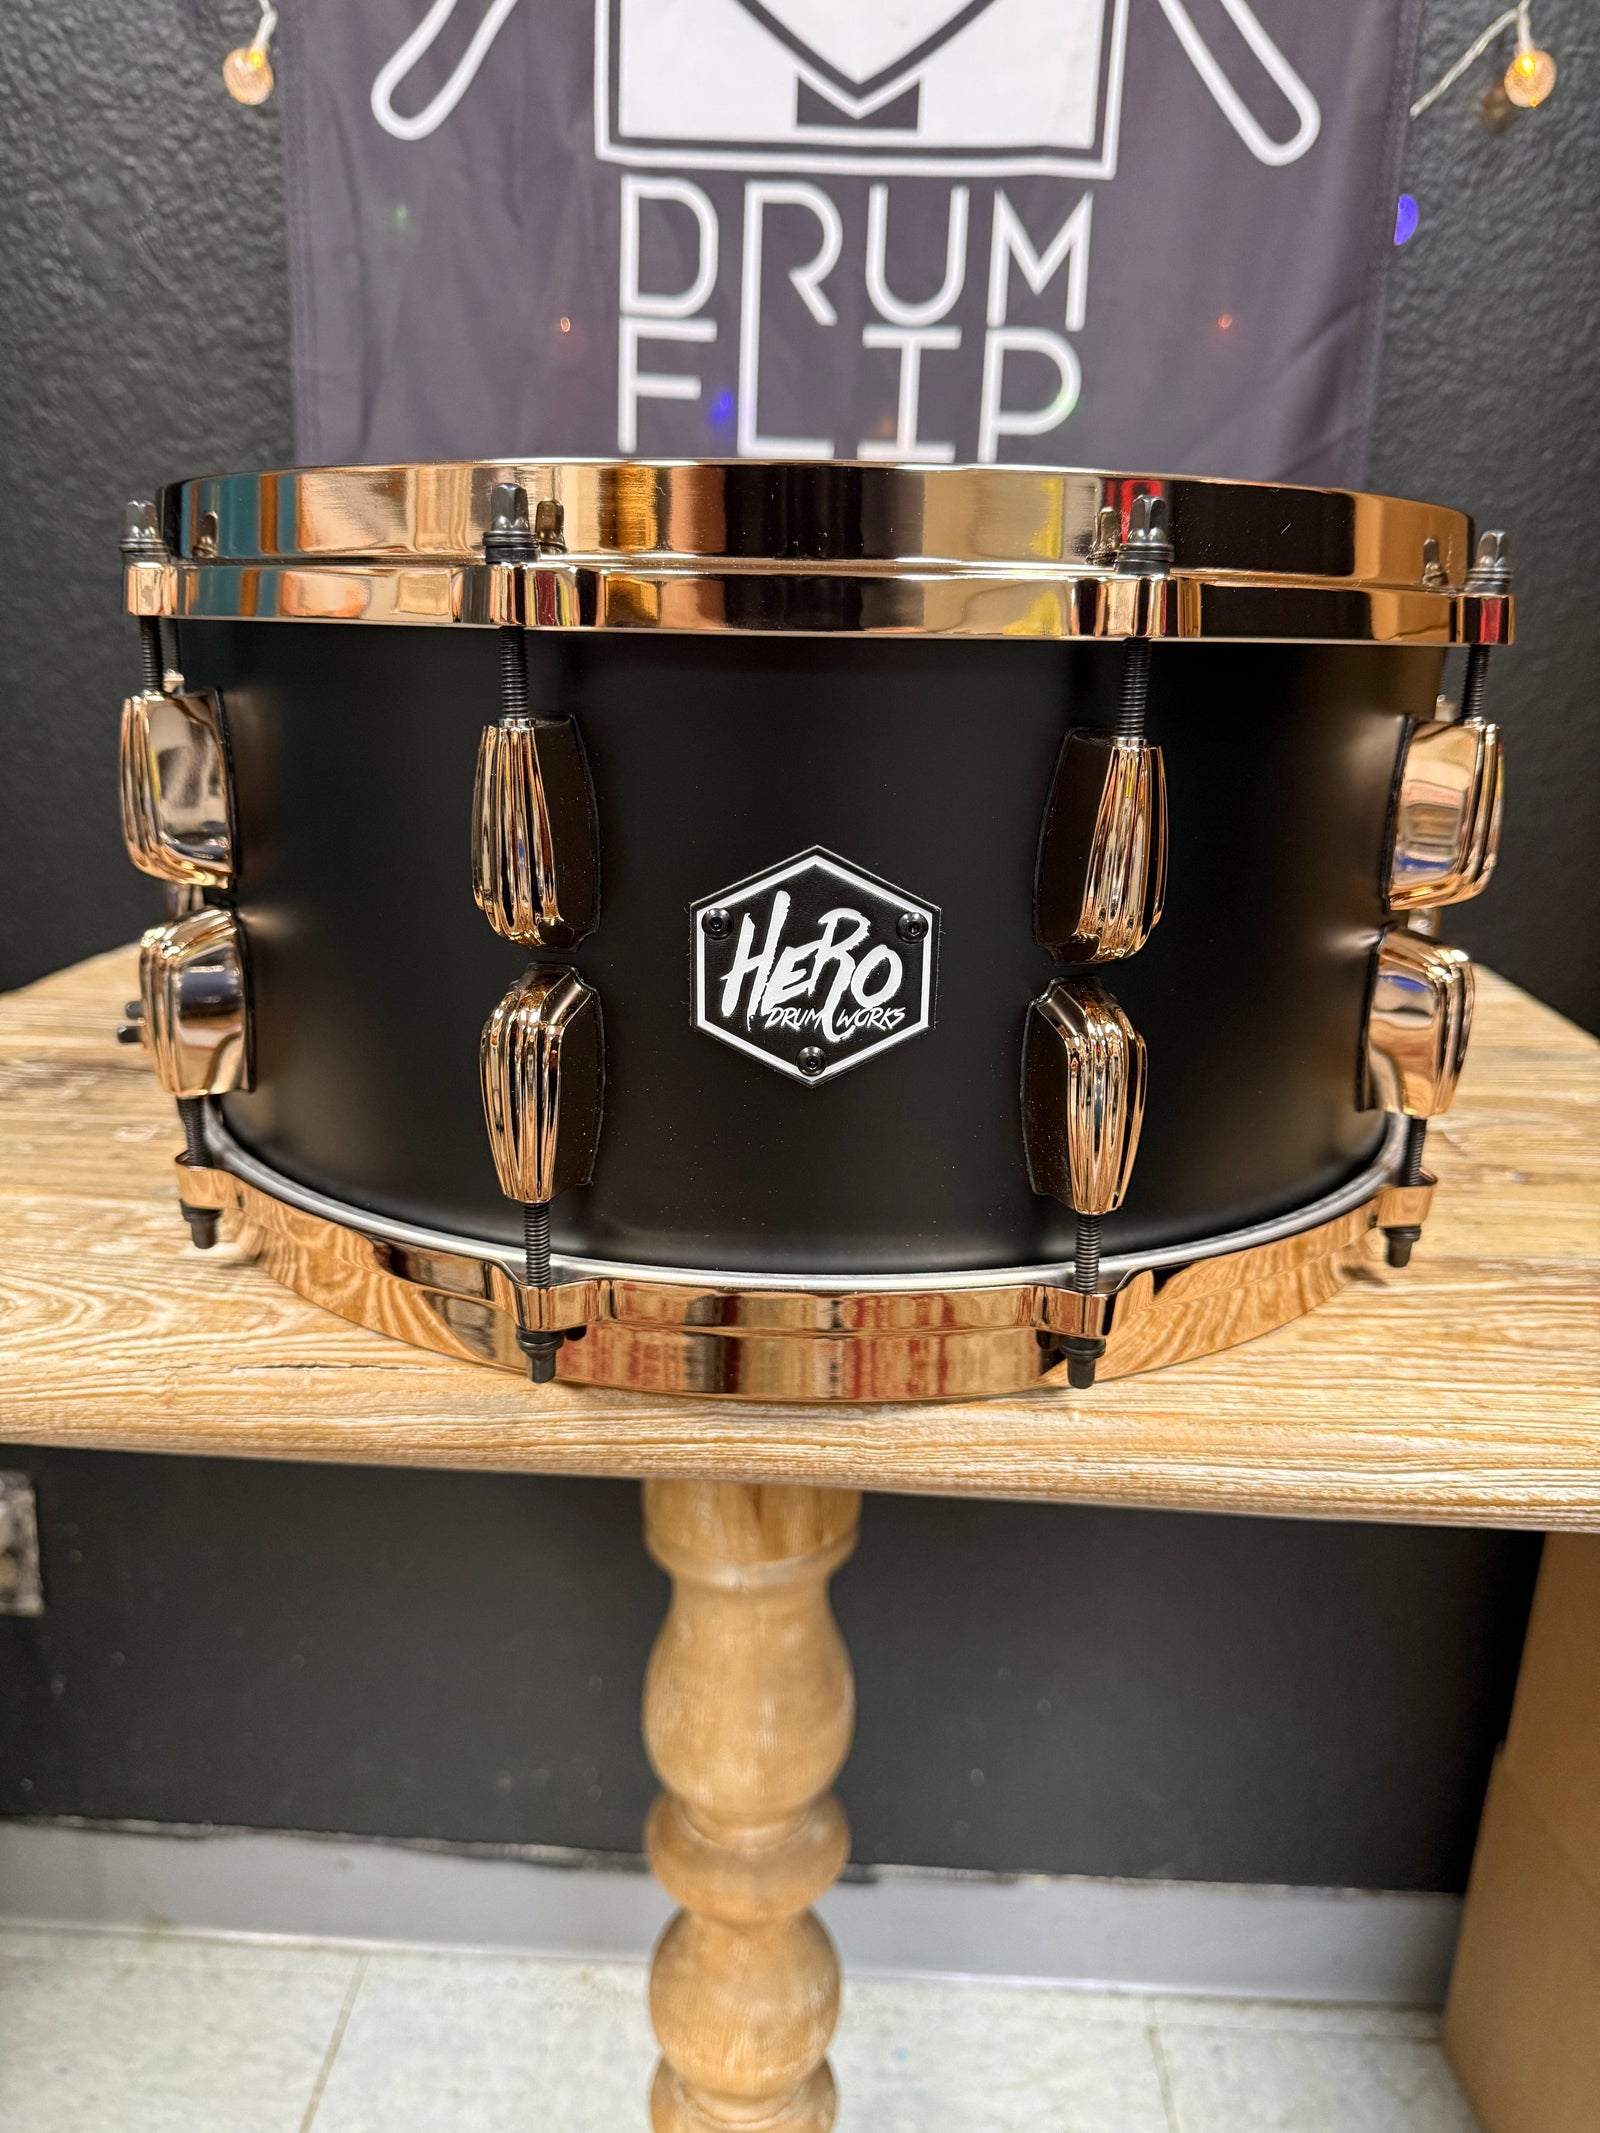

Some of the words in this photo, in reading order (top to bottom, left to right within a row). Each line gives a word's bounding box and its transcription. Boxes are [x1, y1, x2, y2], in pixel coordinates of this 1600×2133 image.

[619, 173, 1094, 332] DRUM
[617, 316, 1083, 463] FLIP
[764, 1007, 823, 1031] DRUM
[836, 1006, 906, 1031] WORKS
